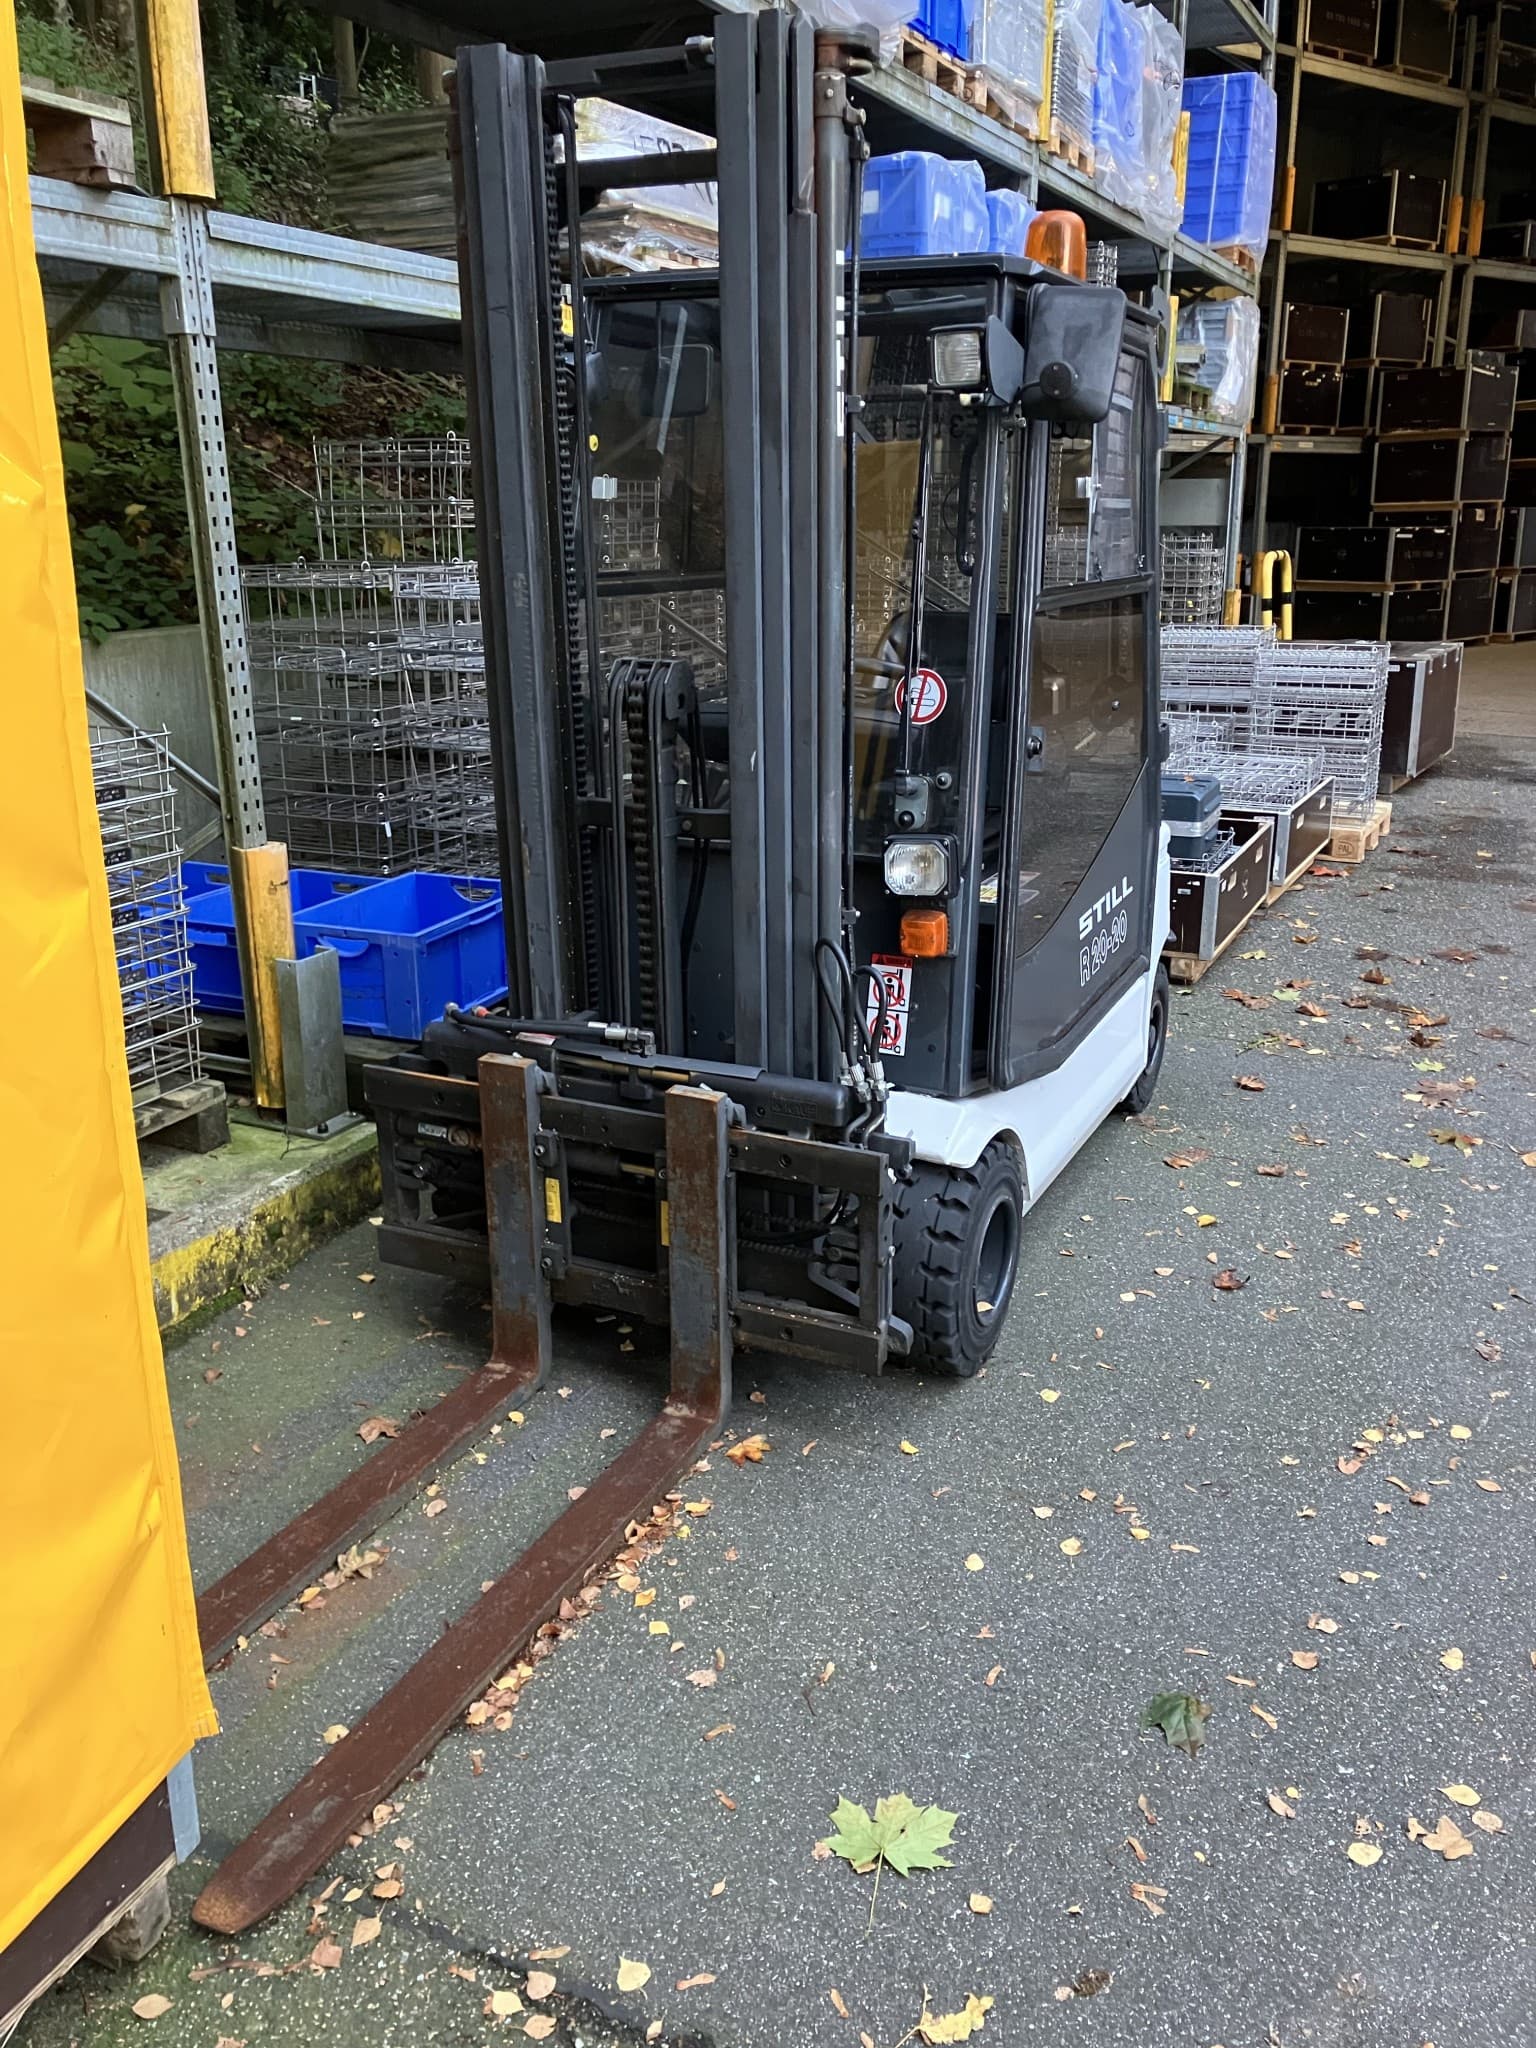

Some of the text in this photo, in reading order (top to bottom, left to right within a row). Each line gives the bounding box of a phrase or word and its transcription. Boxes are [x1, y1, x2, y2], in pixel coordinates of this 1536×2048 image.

[1079, 876, 1134, 941] STILL
[1080, 910, 1127, 987] R 20-20
